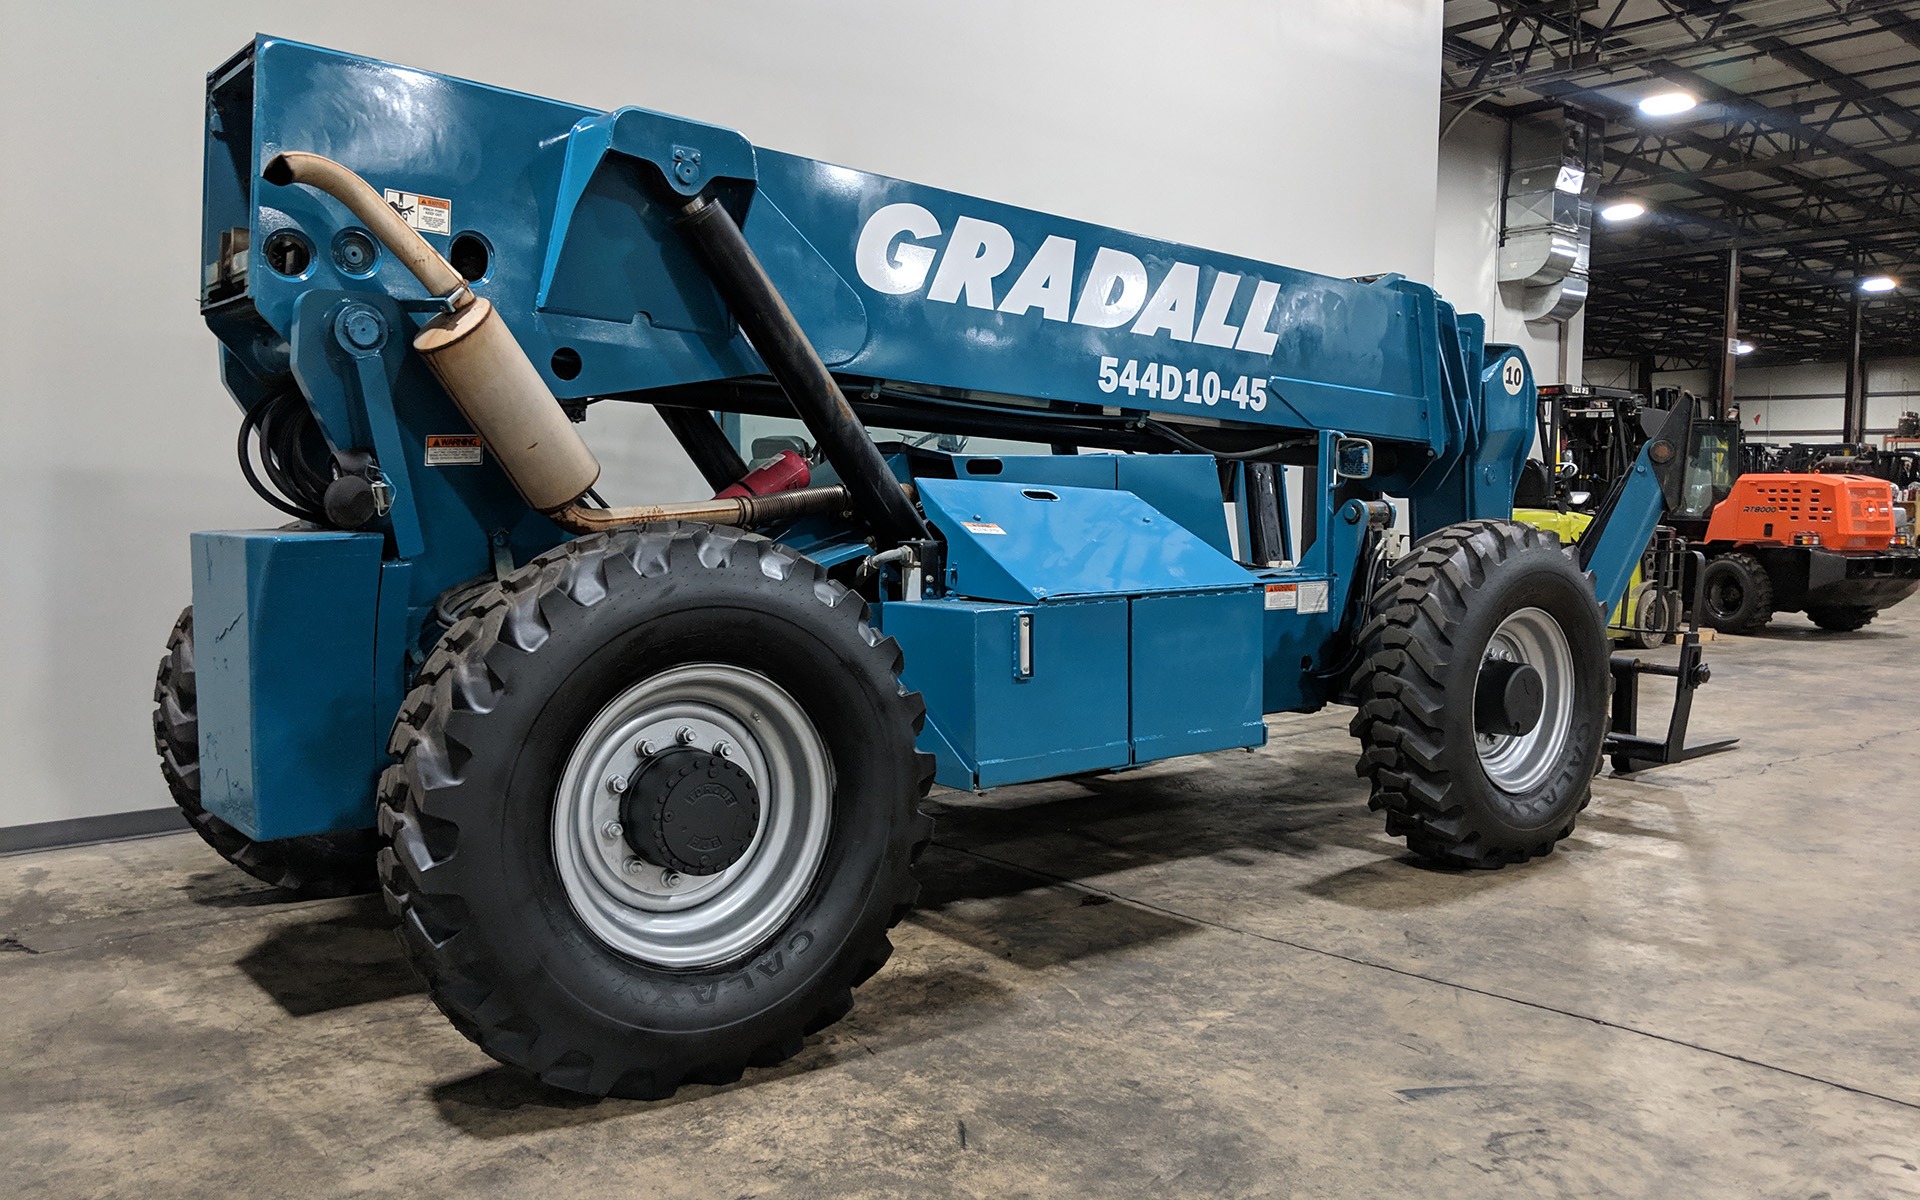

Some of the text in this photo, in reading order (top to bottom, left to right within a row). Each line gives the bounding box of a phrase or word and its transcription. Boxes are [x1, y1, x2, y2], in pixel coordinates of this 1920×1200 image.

[855, 202, 1281, 356] GRADALL
[1098, 356, 1268, 412] 544D10-45
[1505, 366, 1522, 386] 10
[441, 438, 477, 446] WARNING
[687, 784, 735, 806] TORQUE
[614, 930, 815, 1007] GALAXY
